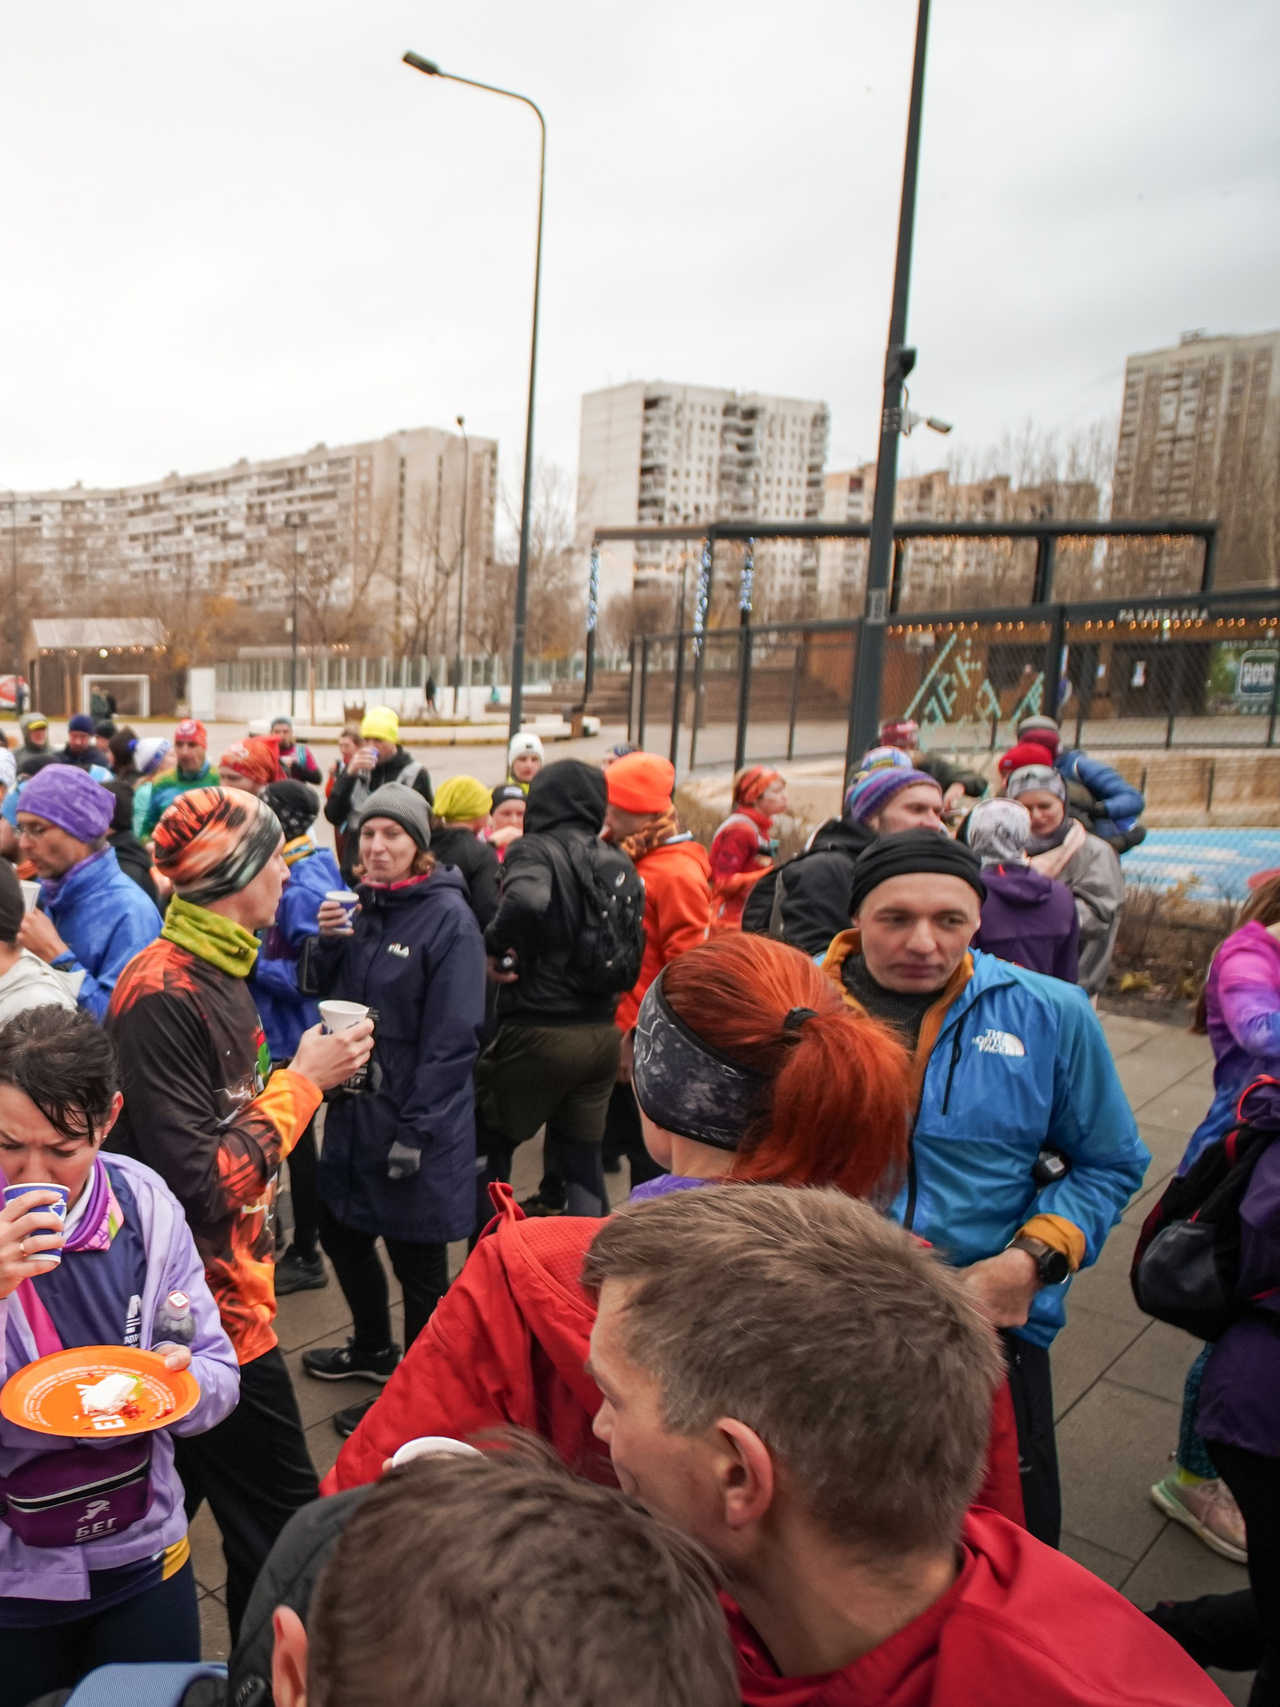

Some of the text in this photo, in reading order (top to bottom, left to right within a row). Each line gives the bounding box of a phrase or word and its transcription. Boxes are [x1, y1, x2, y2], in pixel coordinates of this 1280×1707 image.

[388, 943, 410, 958] FILA
[986, 1028, 1005, 1039] THE
[972, 1035, 1005, 1047] NORTH
[979, 1042, 1006, 1054] FACE
[76, 1517, 118, 1538] БЕГ
